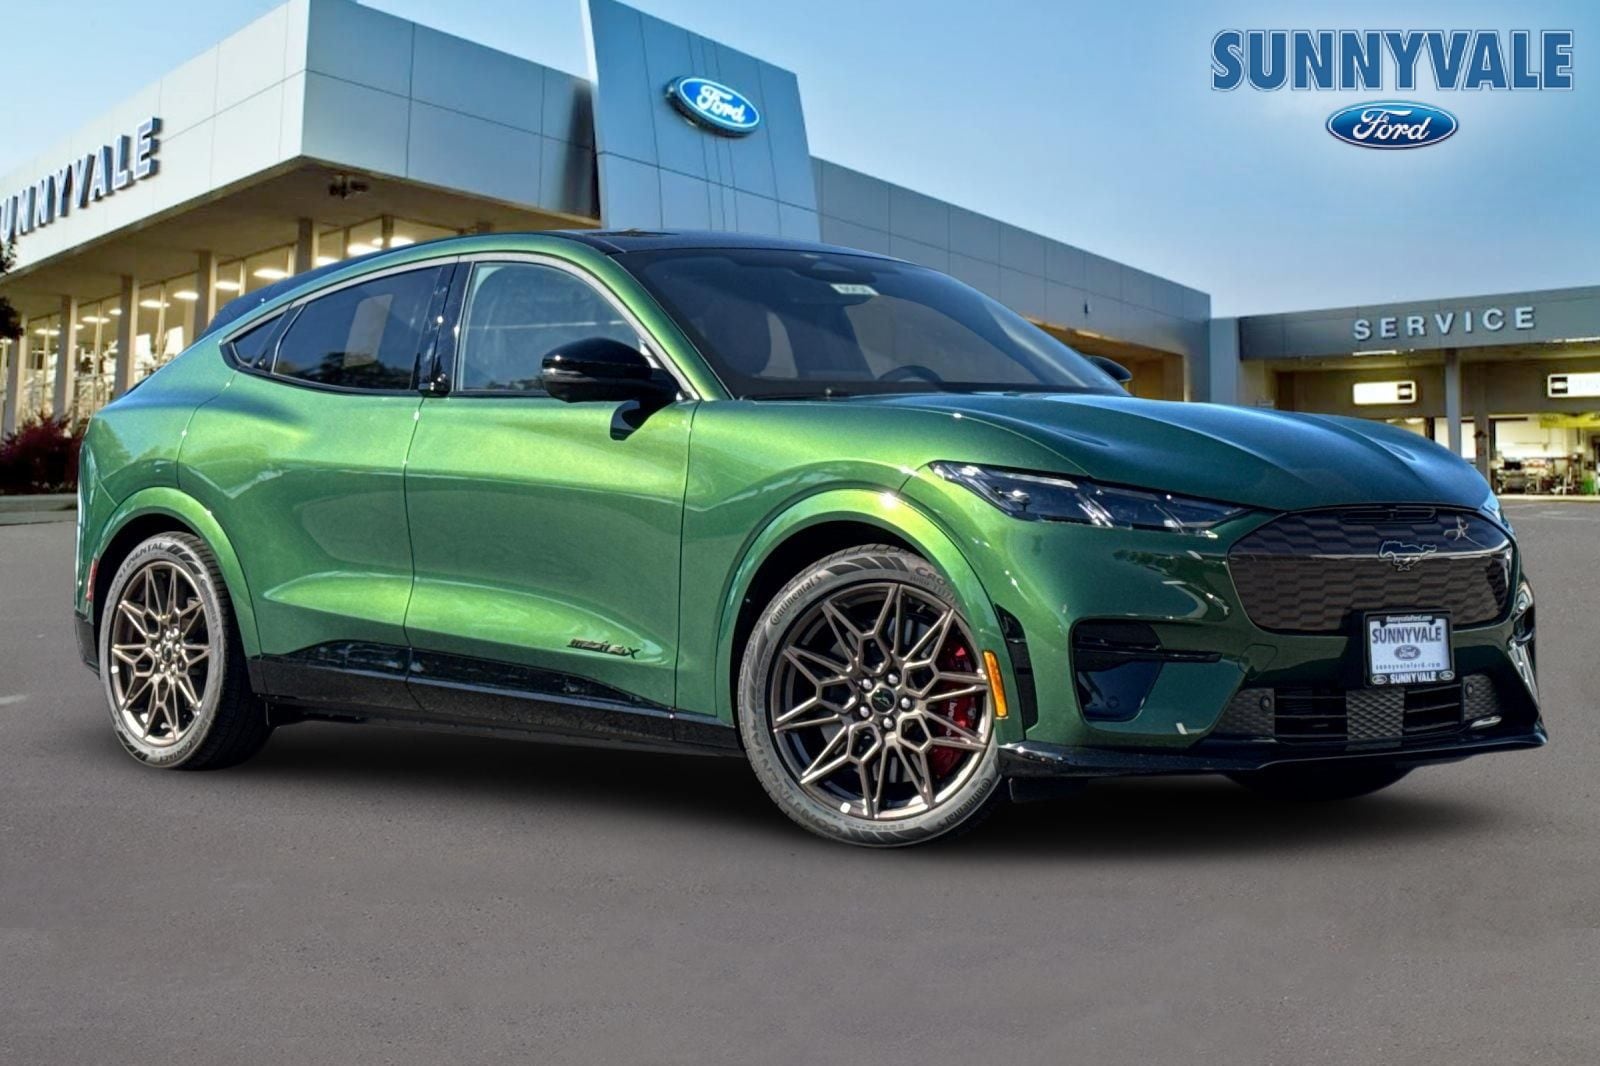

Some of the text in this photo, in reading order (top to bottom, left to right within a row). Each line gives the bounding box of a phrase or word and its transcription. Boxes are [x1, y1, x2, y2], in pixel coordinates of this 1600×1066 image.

[696, 84, 746, 123] Ford
[0, 116, 163, 243] UNNYVALE
[1353, 306, 1535, 341] SERVICE
[770, 577, 815, 626] Continental
[1372, 627, 1442, 644] SUNNYVALE
[1390, 671, 1437, 684] SUNNYVALE
